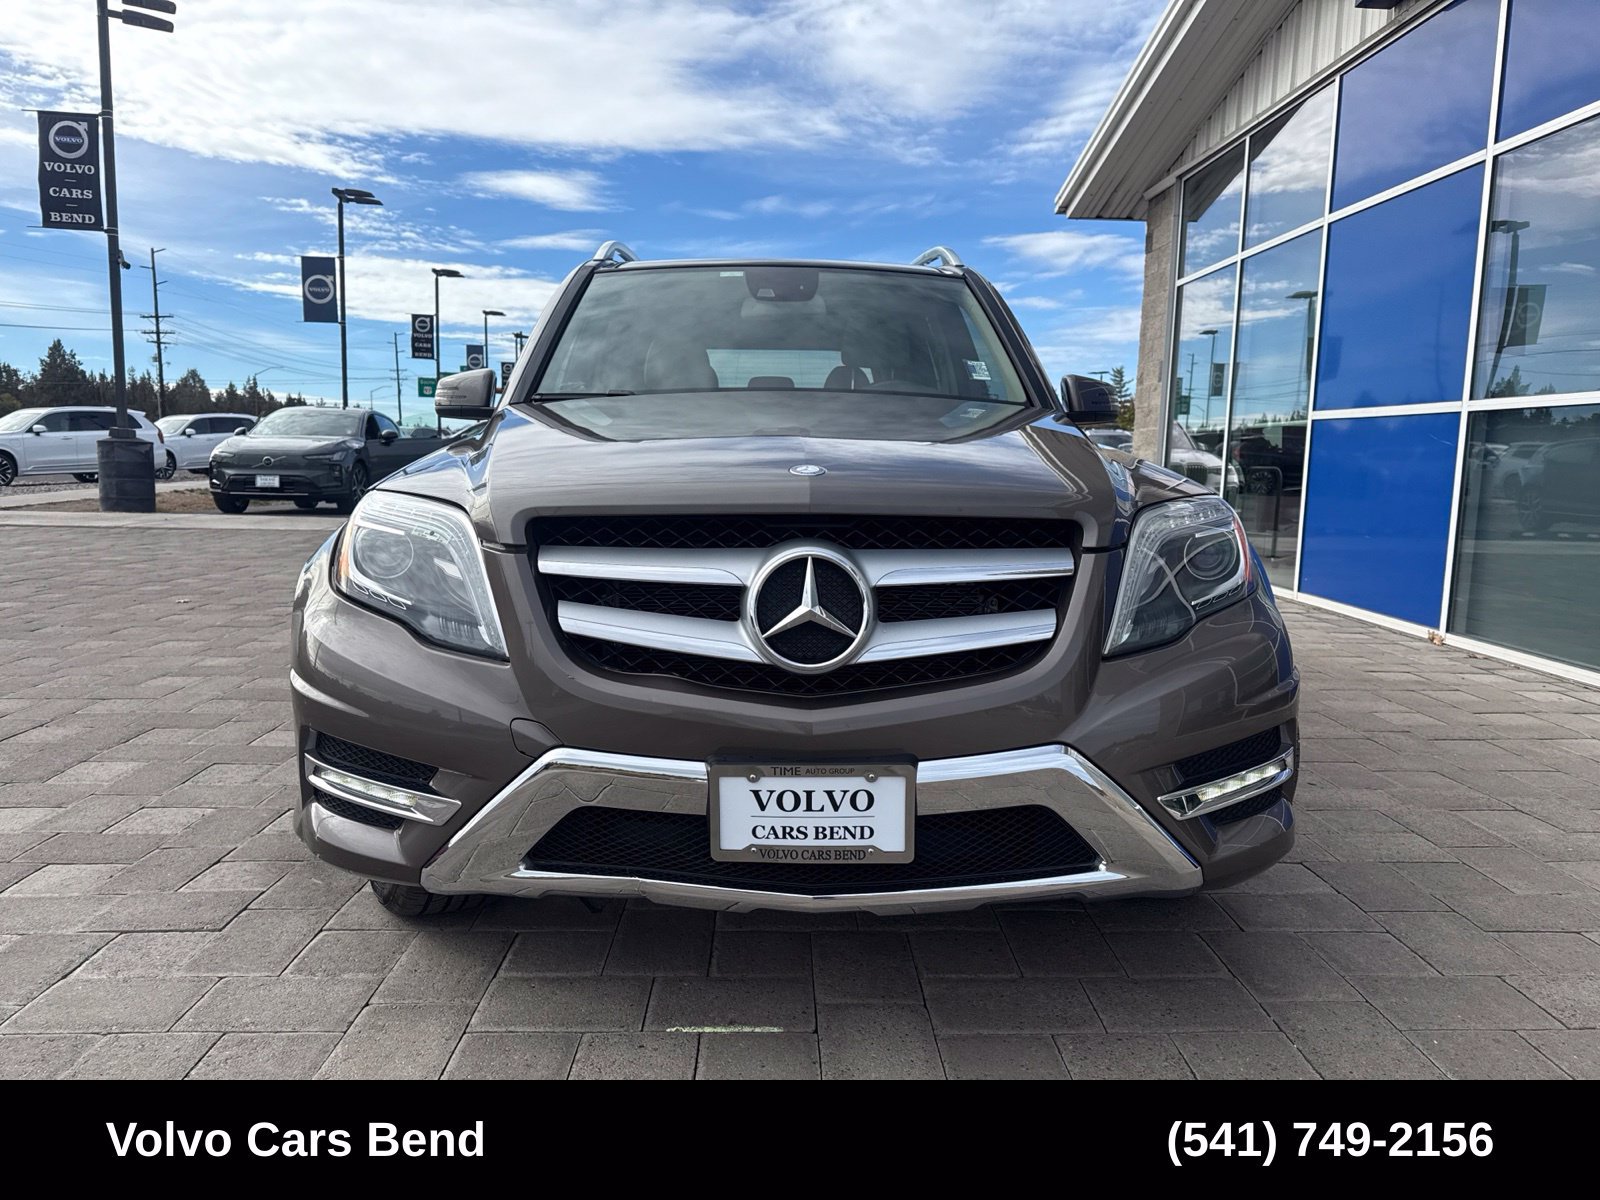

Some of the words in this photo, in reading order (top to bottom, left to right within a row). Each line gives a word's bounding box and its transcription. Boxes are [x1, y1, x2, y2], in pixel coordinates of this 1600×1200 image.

[54, 136, 83, 144] VOLVO
[43, 161, 95, 175] VOLVO
[49, 187, 93, 199] CARS
[49, 211, 96, 224] BEND
[770, 766, 801, 776] TIME
[749, 789, 875, 813] VOLVO
[751, 824, 809, 840] CARS
[813, 825, 875, 841] BEND
[758, 848, 799, 860] VOLVO
[801, 848, 832, 861] CARS
[834, 848, 867, 861] BEND
